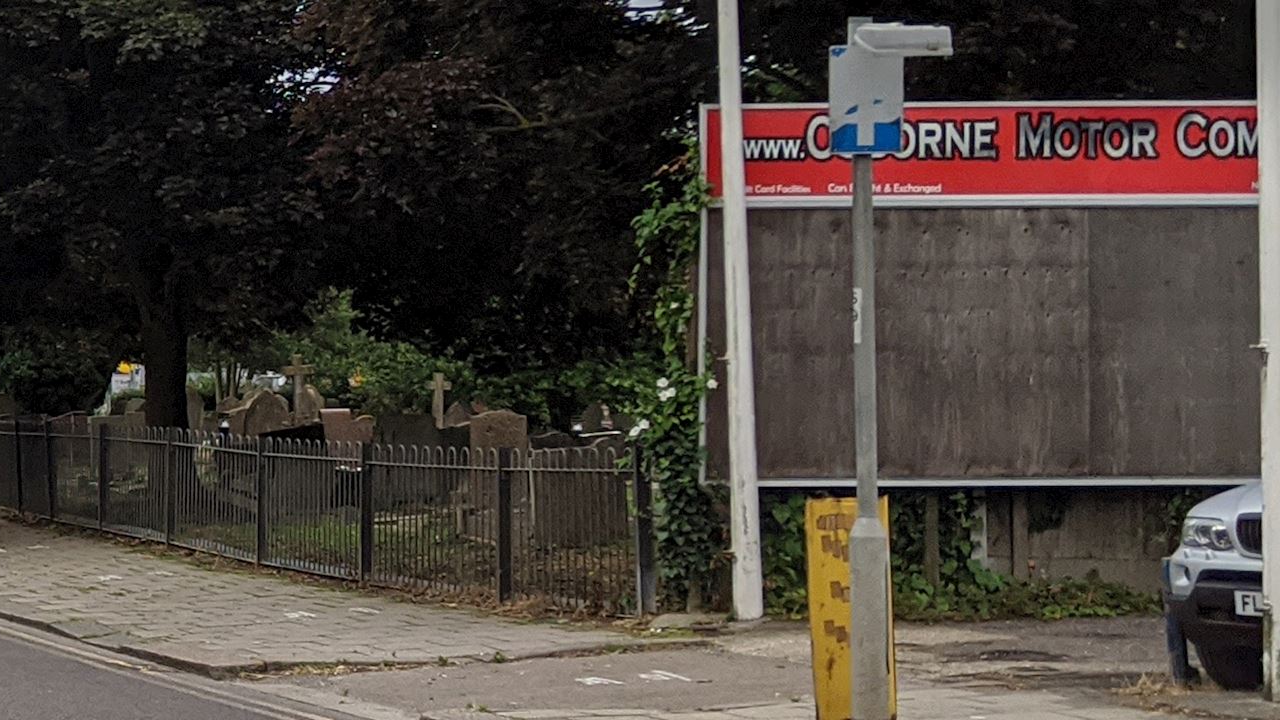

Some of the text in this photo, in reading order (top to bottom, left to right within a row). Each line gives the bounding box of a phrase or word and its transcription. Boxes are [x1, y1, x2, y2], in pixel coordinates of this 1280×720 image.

[743, 113, 998, 161] www.OORNE
[1016, 112, 1160, 161] MOTOR
[755, 184, 775, 194] Card
[777, 183, 811, 194] Facilities
[884, 183, 891, 193] &
[893, 183, 942, 195] Exchanged
